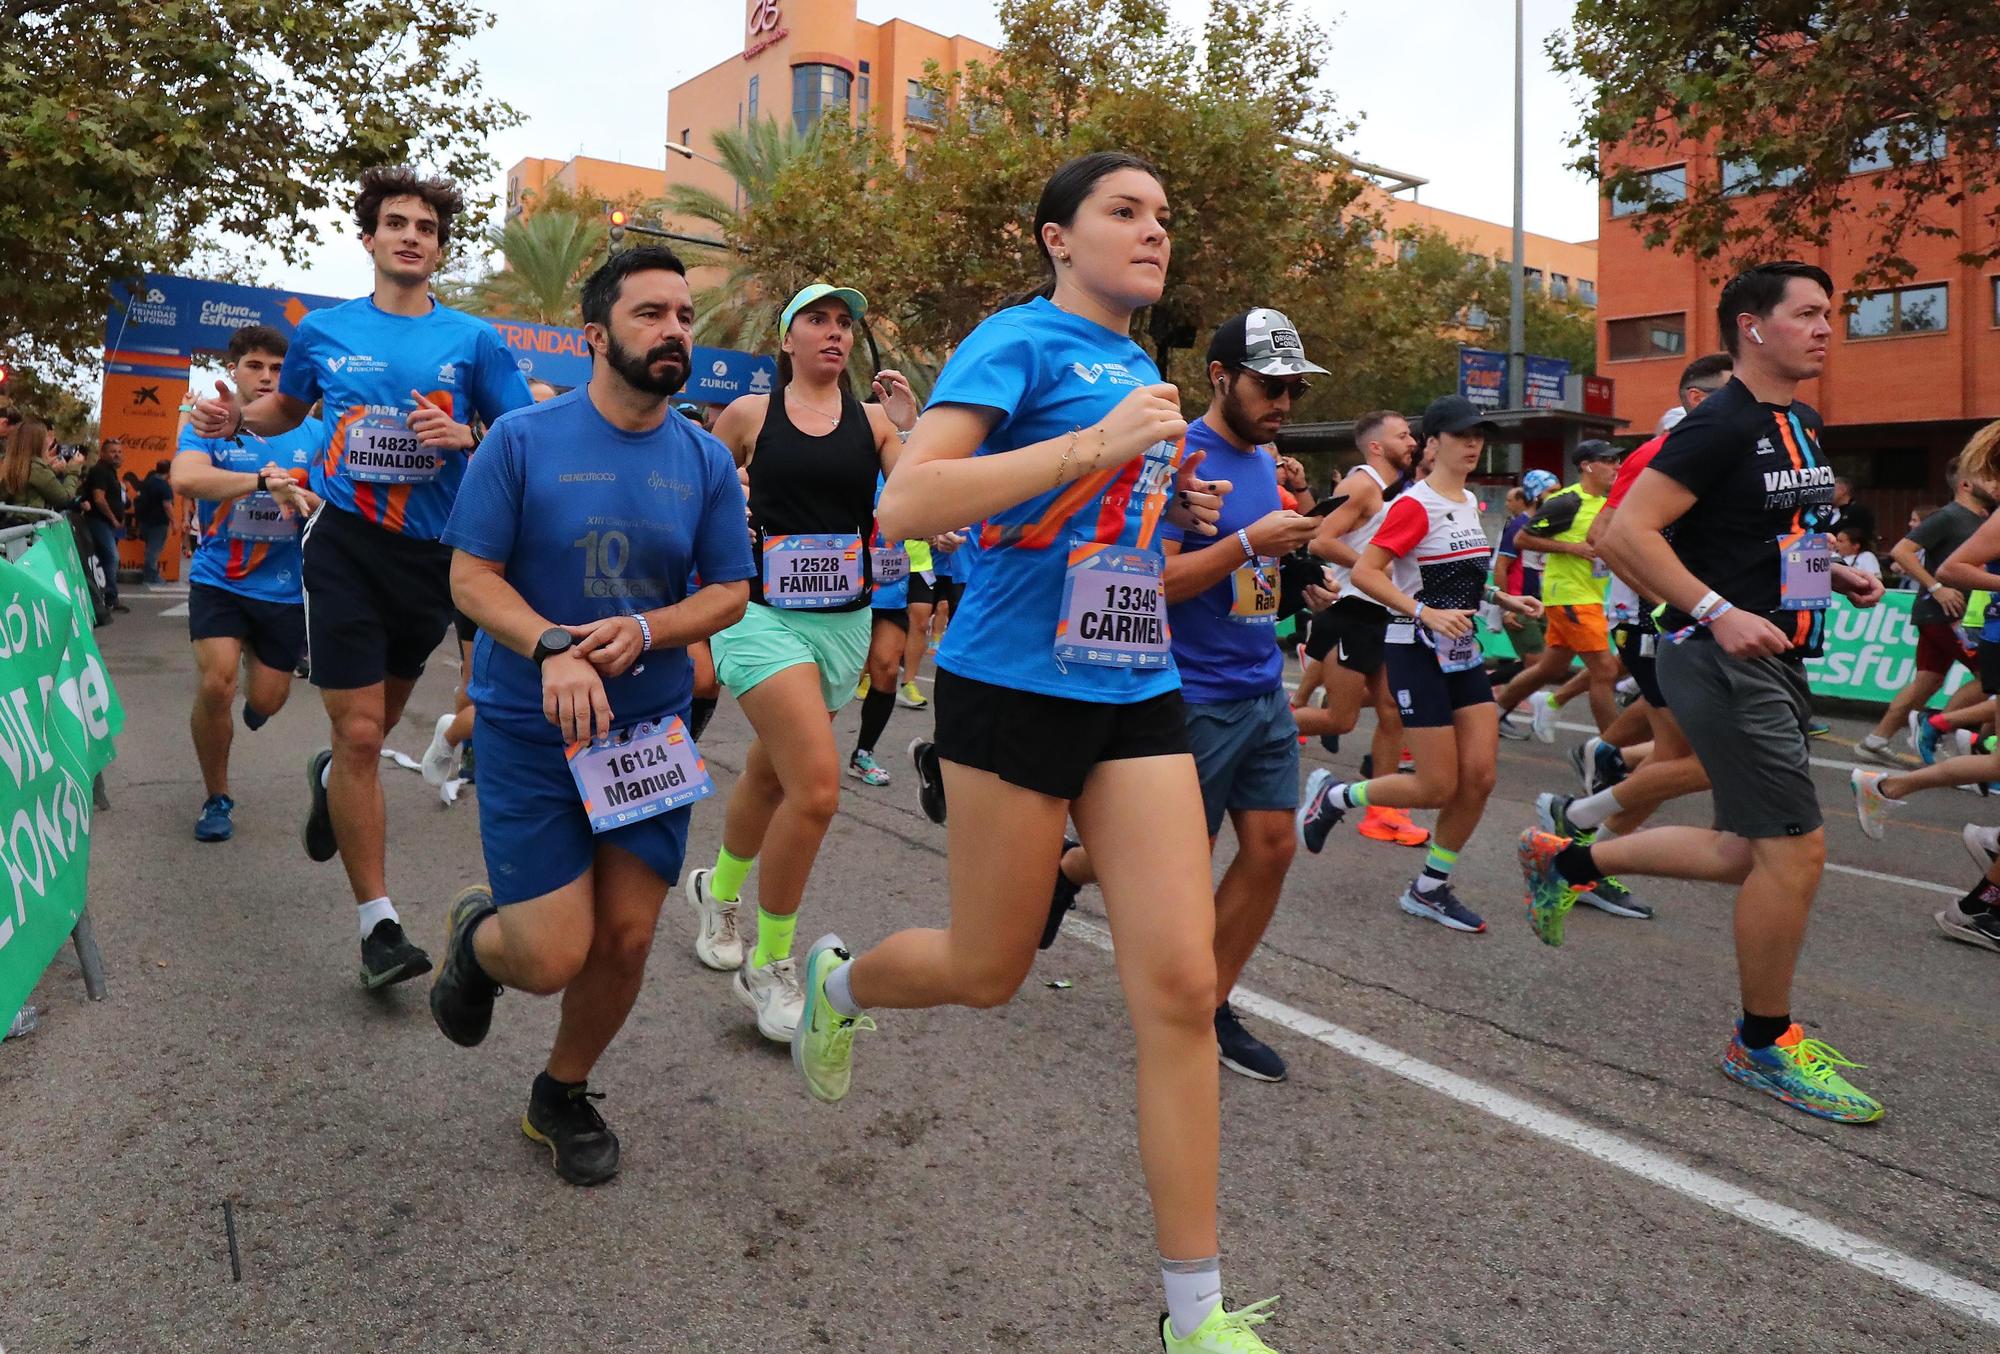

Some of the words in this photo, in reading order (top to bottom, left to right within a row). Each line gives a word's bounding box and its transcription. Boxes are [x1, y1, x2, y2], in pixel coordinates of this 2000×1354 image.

[131, 308, 176, 319] TRINIDAD
[201, 300, 249, 318] Cultura
[132, 316, 176, 327] ALFONSO
[700, 377, 738, 391] ZURICH
[368, 435, 418, 453] 14823
[349, 450, 435, 469] REINALDOS
[574, 530, 630, 579] 10
[790, 557, 840, 573] 12528
[780, 575, 850, 593] FAMILIA
[1105, 584, 1157, 613] 13349
[1080, 611, 1164, 645] CARMEN
[606, 744, 668, 778] 16124
[603, 763, 688, 808] Manuel
